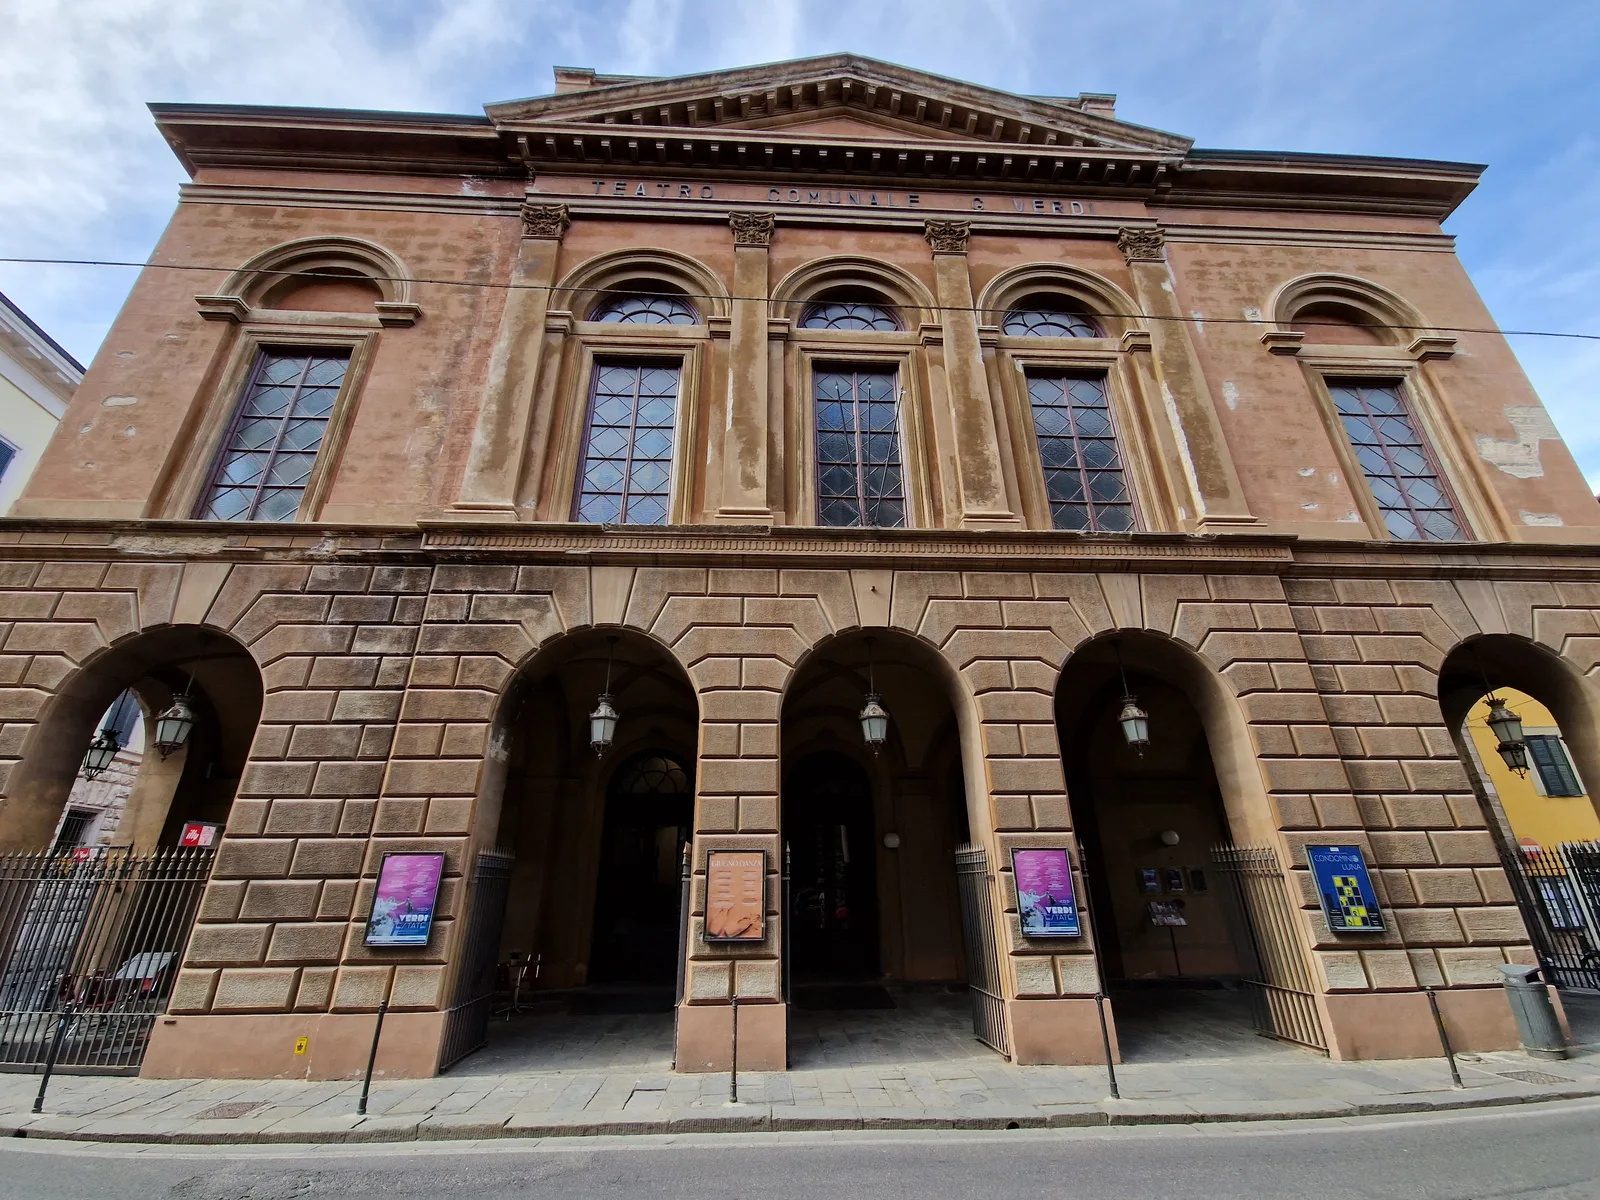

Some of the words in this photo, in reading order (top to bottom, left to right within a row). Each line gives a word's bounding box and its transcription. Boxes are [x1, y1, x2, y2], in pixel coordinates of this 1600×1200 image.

[592, 180, 714, 199] TEATRO
[767, 188, 920, 208] COMUNALE
[971, 197, 985, 211] G
[1012, 198, 1096, 216] VERDI
[185, 829, 200, 842] illy
[1341, 863, 1363, 871] LUNA
[1045, 906, 1073, 914] VERDI
[399, 914, 429, 922] VERDI
